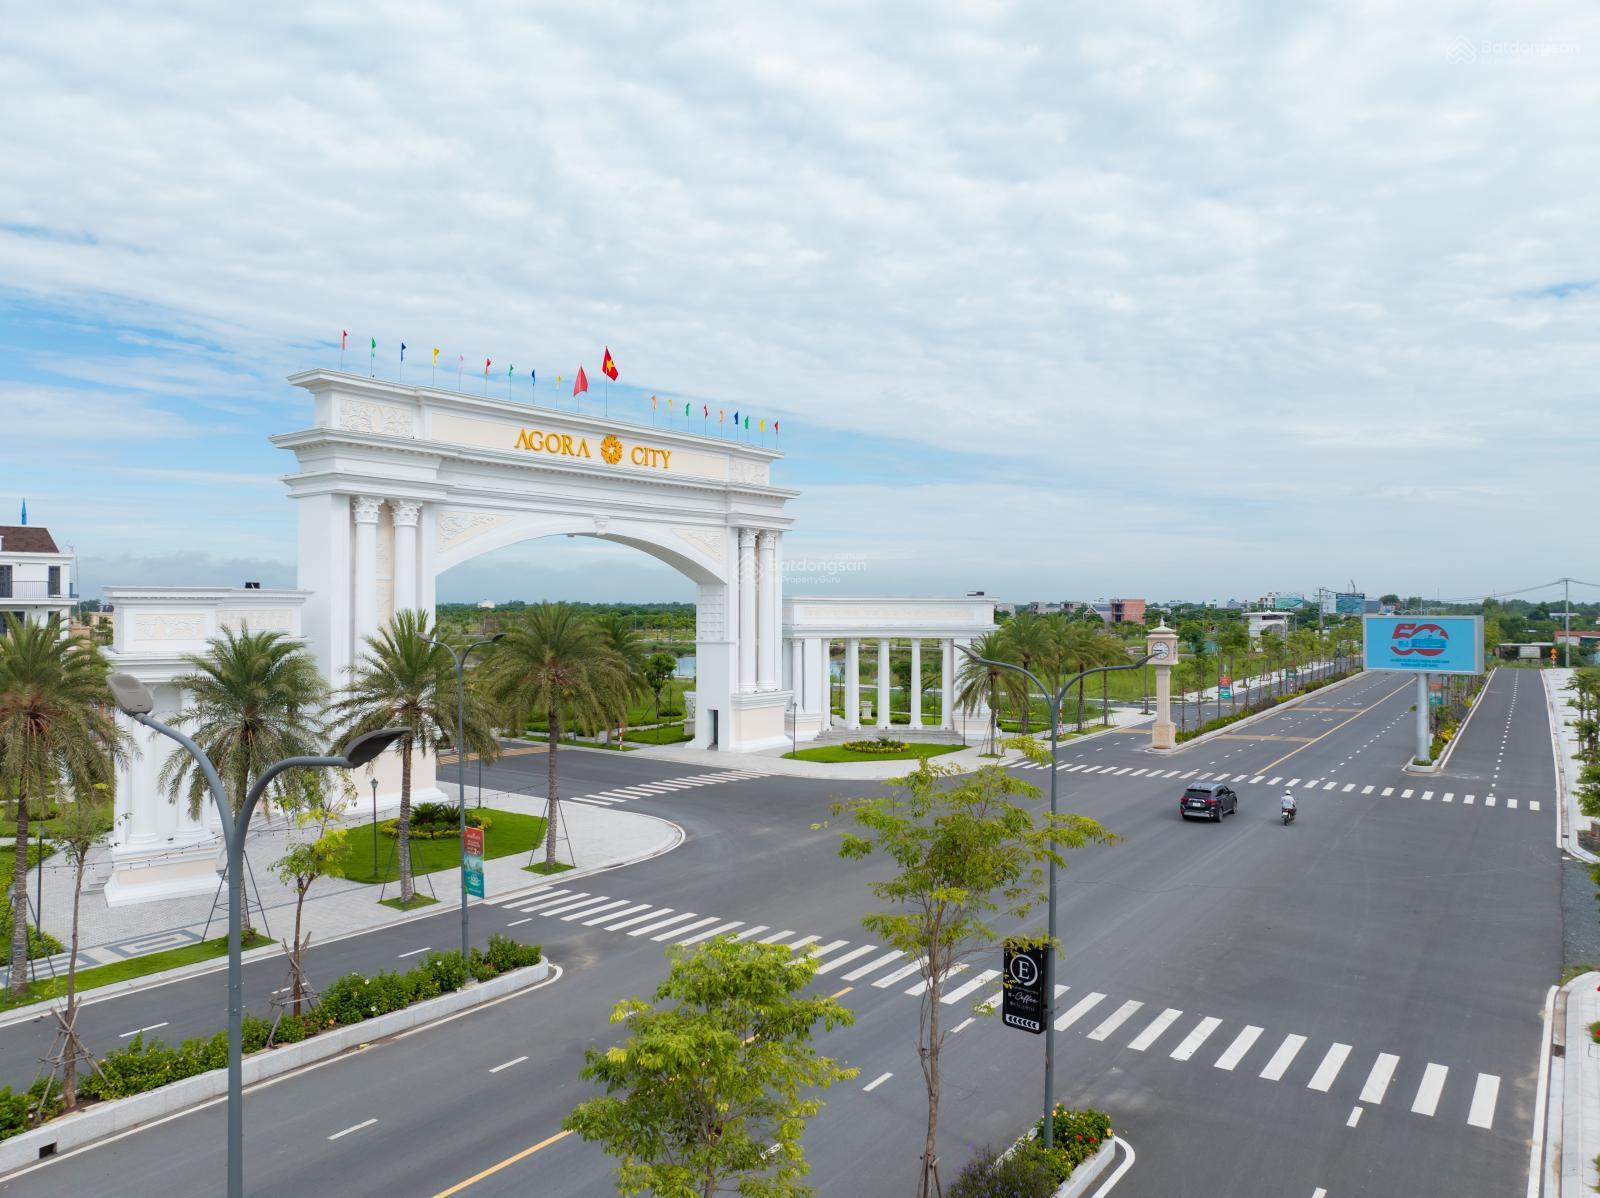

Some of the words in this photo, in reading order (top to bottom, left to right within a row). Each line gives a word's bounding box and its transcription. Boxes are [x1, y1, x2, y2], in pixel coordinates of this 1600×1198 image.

[514, 427, 591, 458] AGORA
[631, 446, 672, 469] CITY
[1391, 623, 1450, 656] 50
[1018, 960, 1030, 980] E
